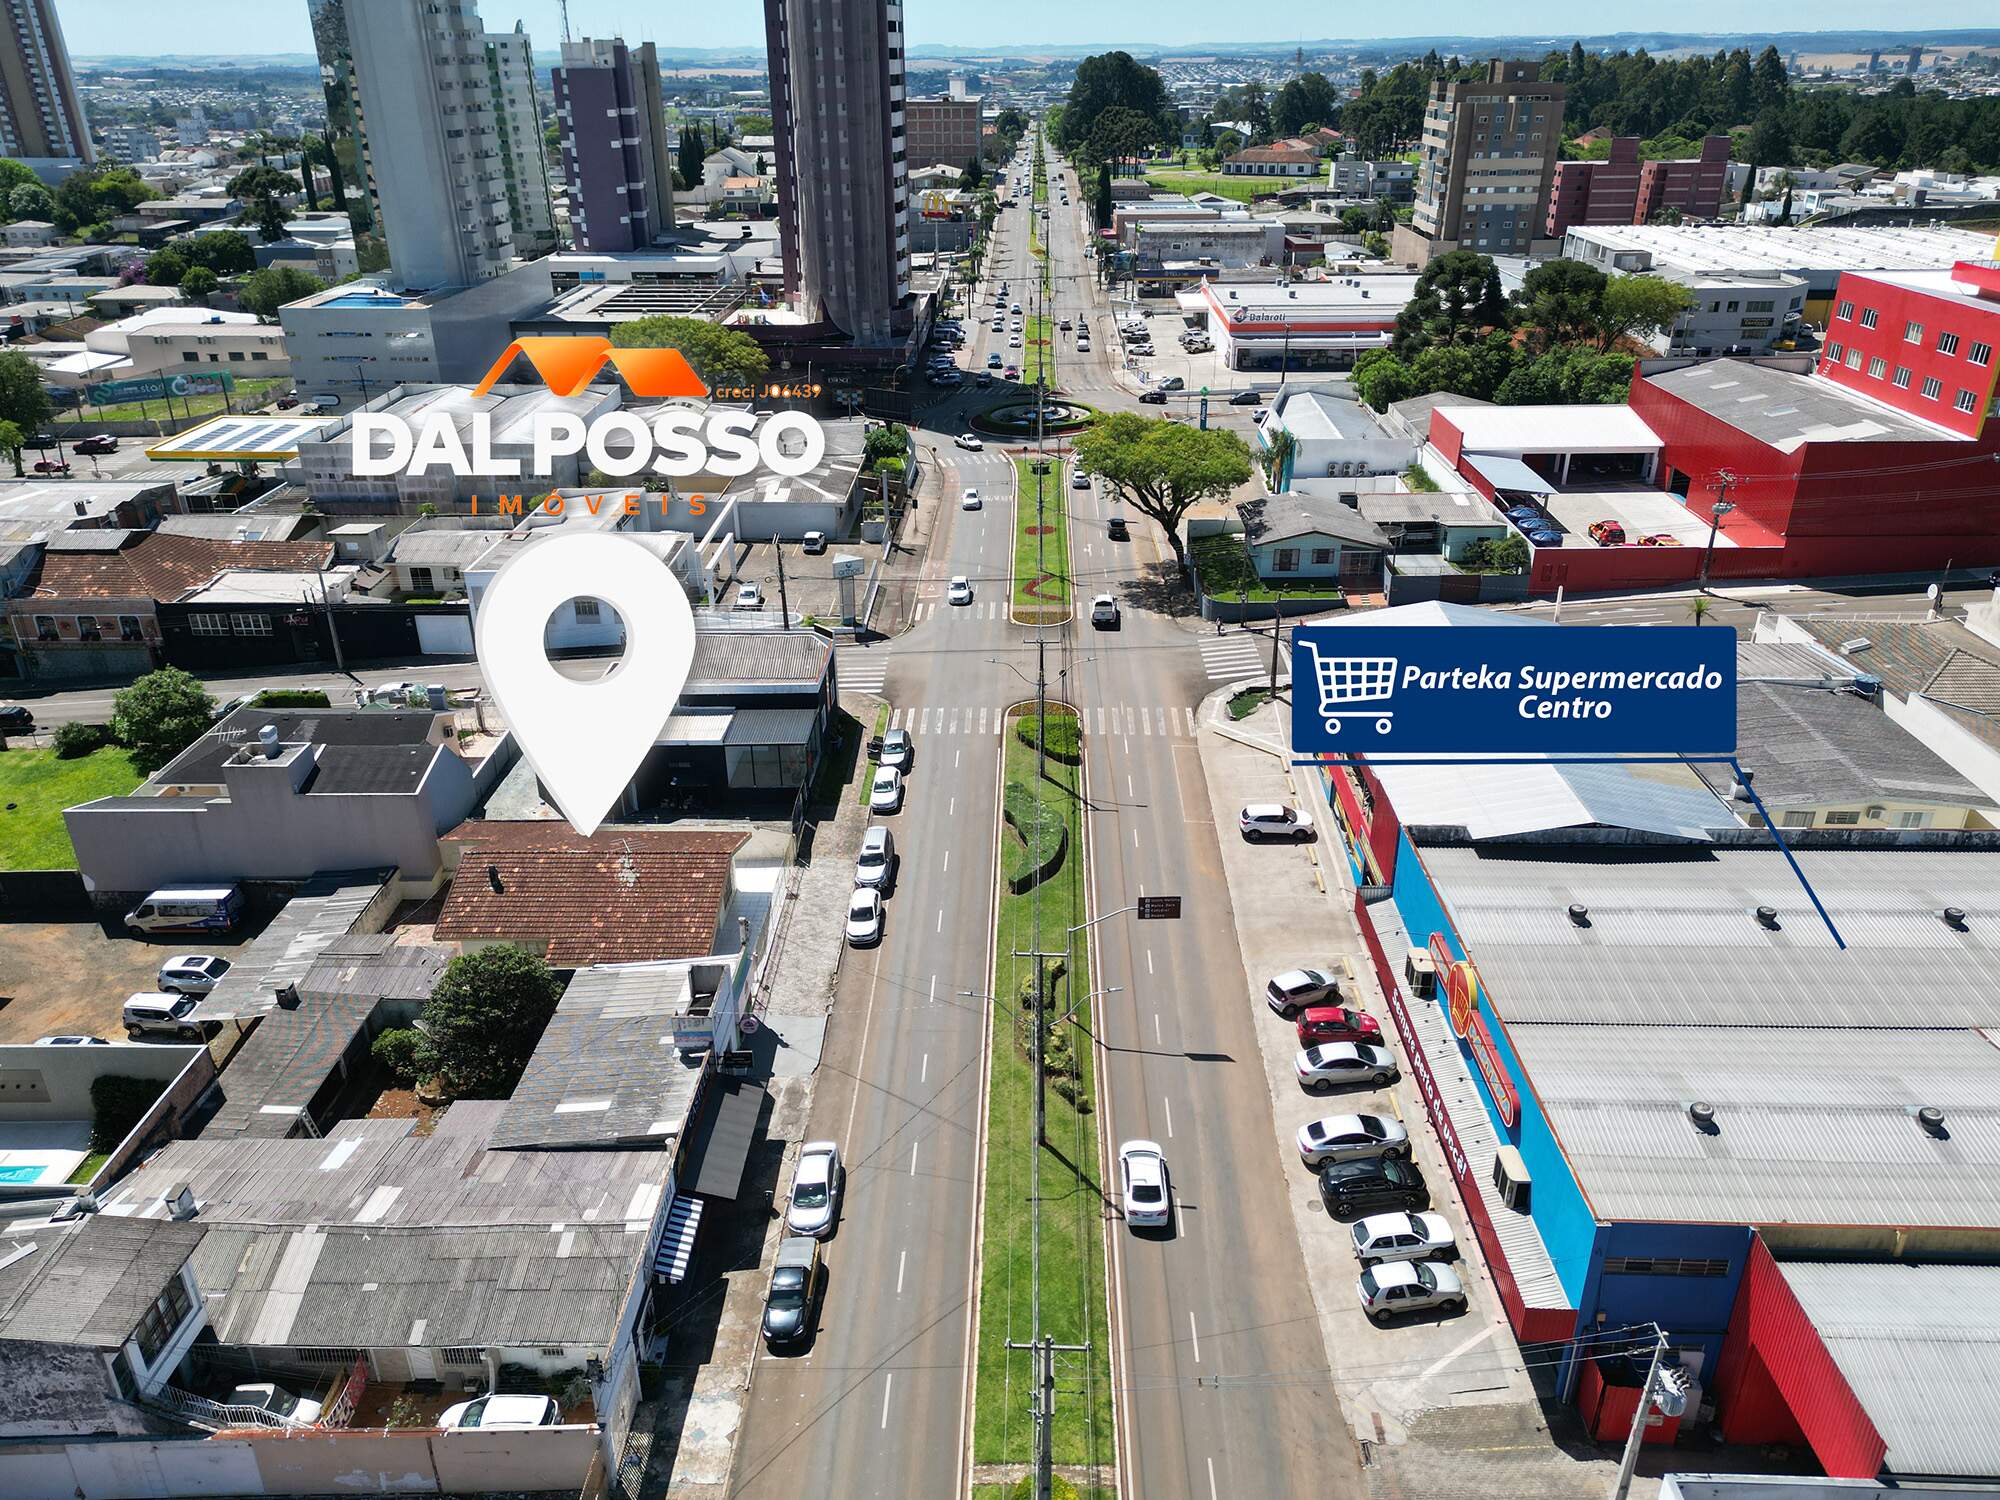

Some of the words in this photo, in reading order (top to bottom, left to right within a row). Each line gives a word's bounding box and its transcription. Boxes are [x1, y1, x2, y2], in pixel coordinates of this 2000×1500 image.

[1249, 313, 1286, 321] Balaroti
[1392, 988, 1416, 1052] Sempre
[1414, 1055, 1434, 1100] perto
[1433, 1098, 1444, 1122] de
[1443, 1122, 1467, 1182] você!
